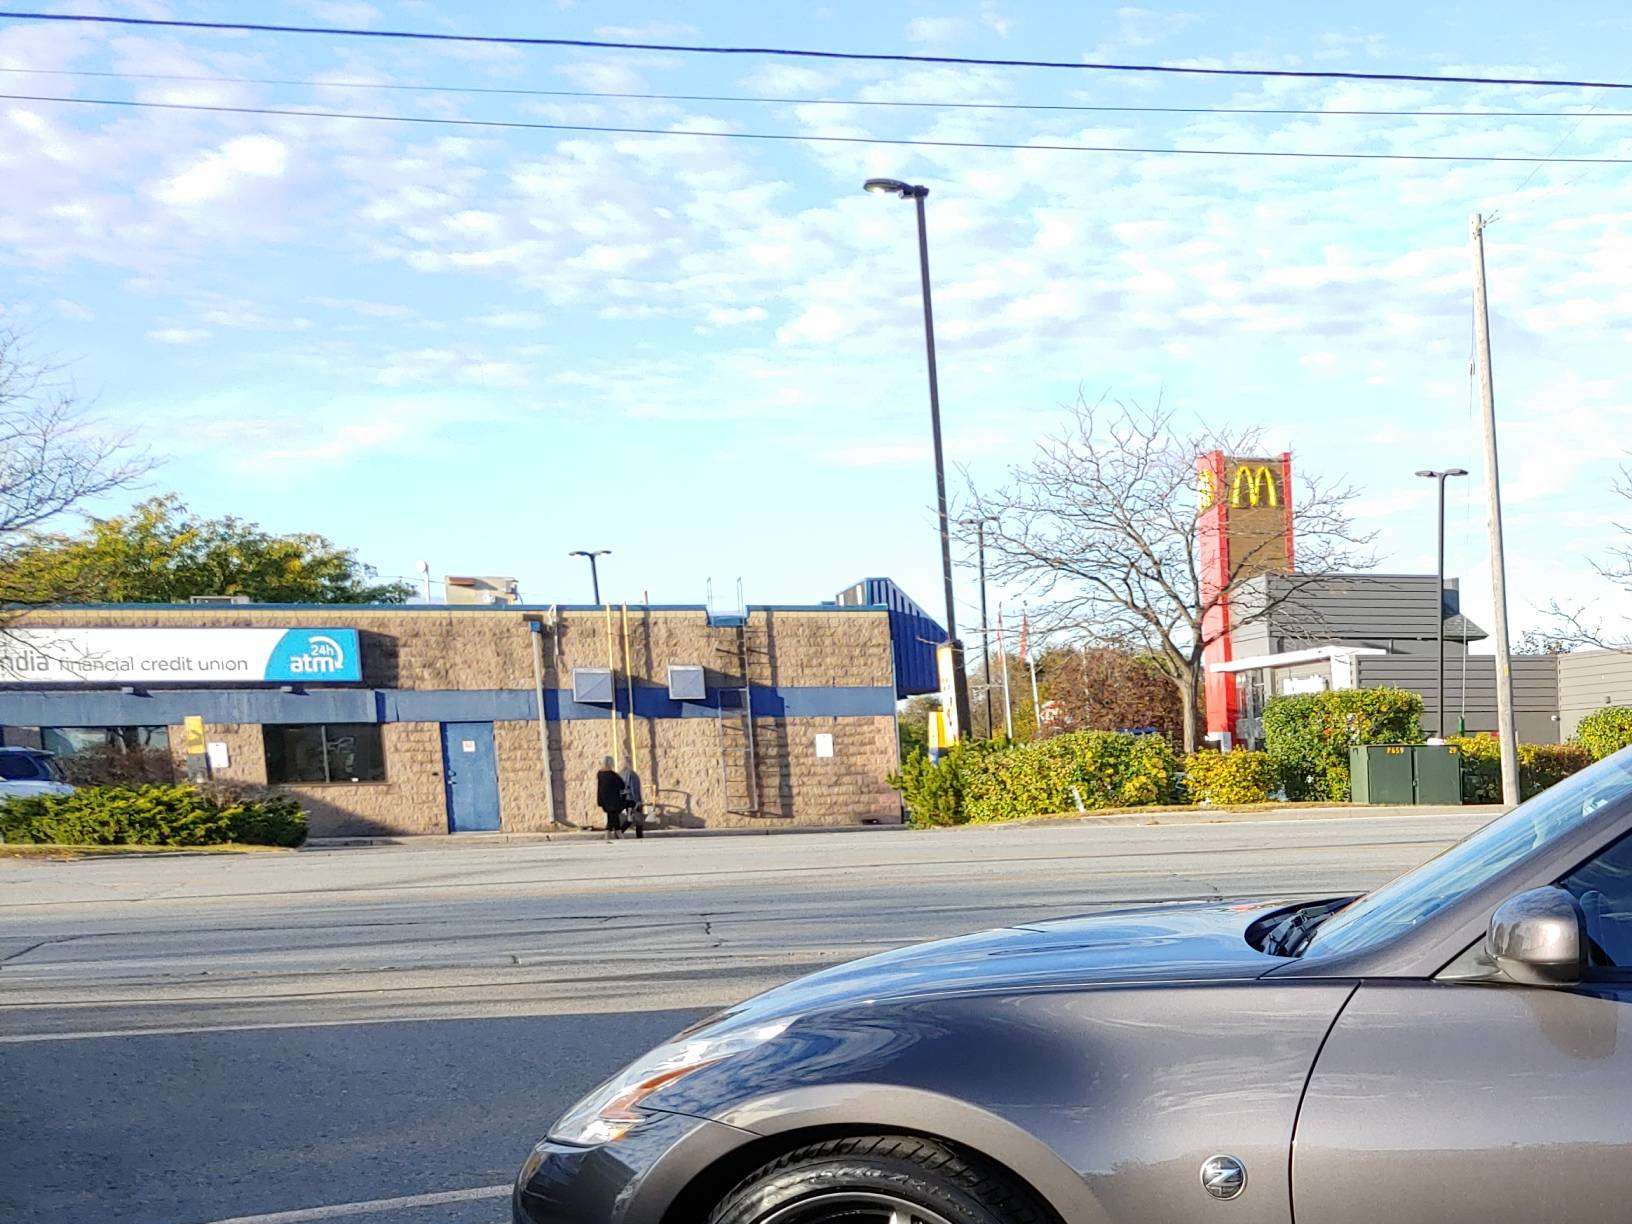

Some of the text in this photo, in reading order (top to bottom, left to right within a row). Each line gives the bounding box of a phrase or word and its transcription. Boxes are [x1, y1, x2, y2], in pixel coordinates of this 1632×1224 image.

[310, 644, 335, 657] 24h
[59, 656, 135, 672] financial
[140, 656, 194, 672] credit
[198, 657, 249, 672] union
[290, 653, 335, 673] atm
